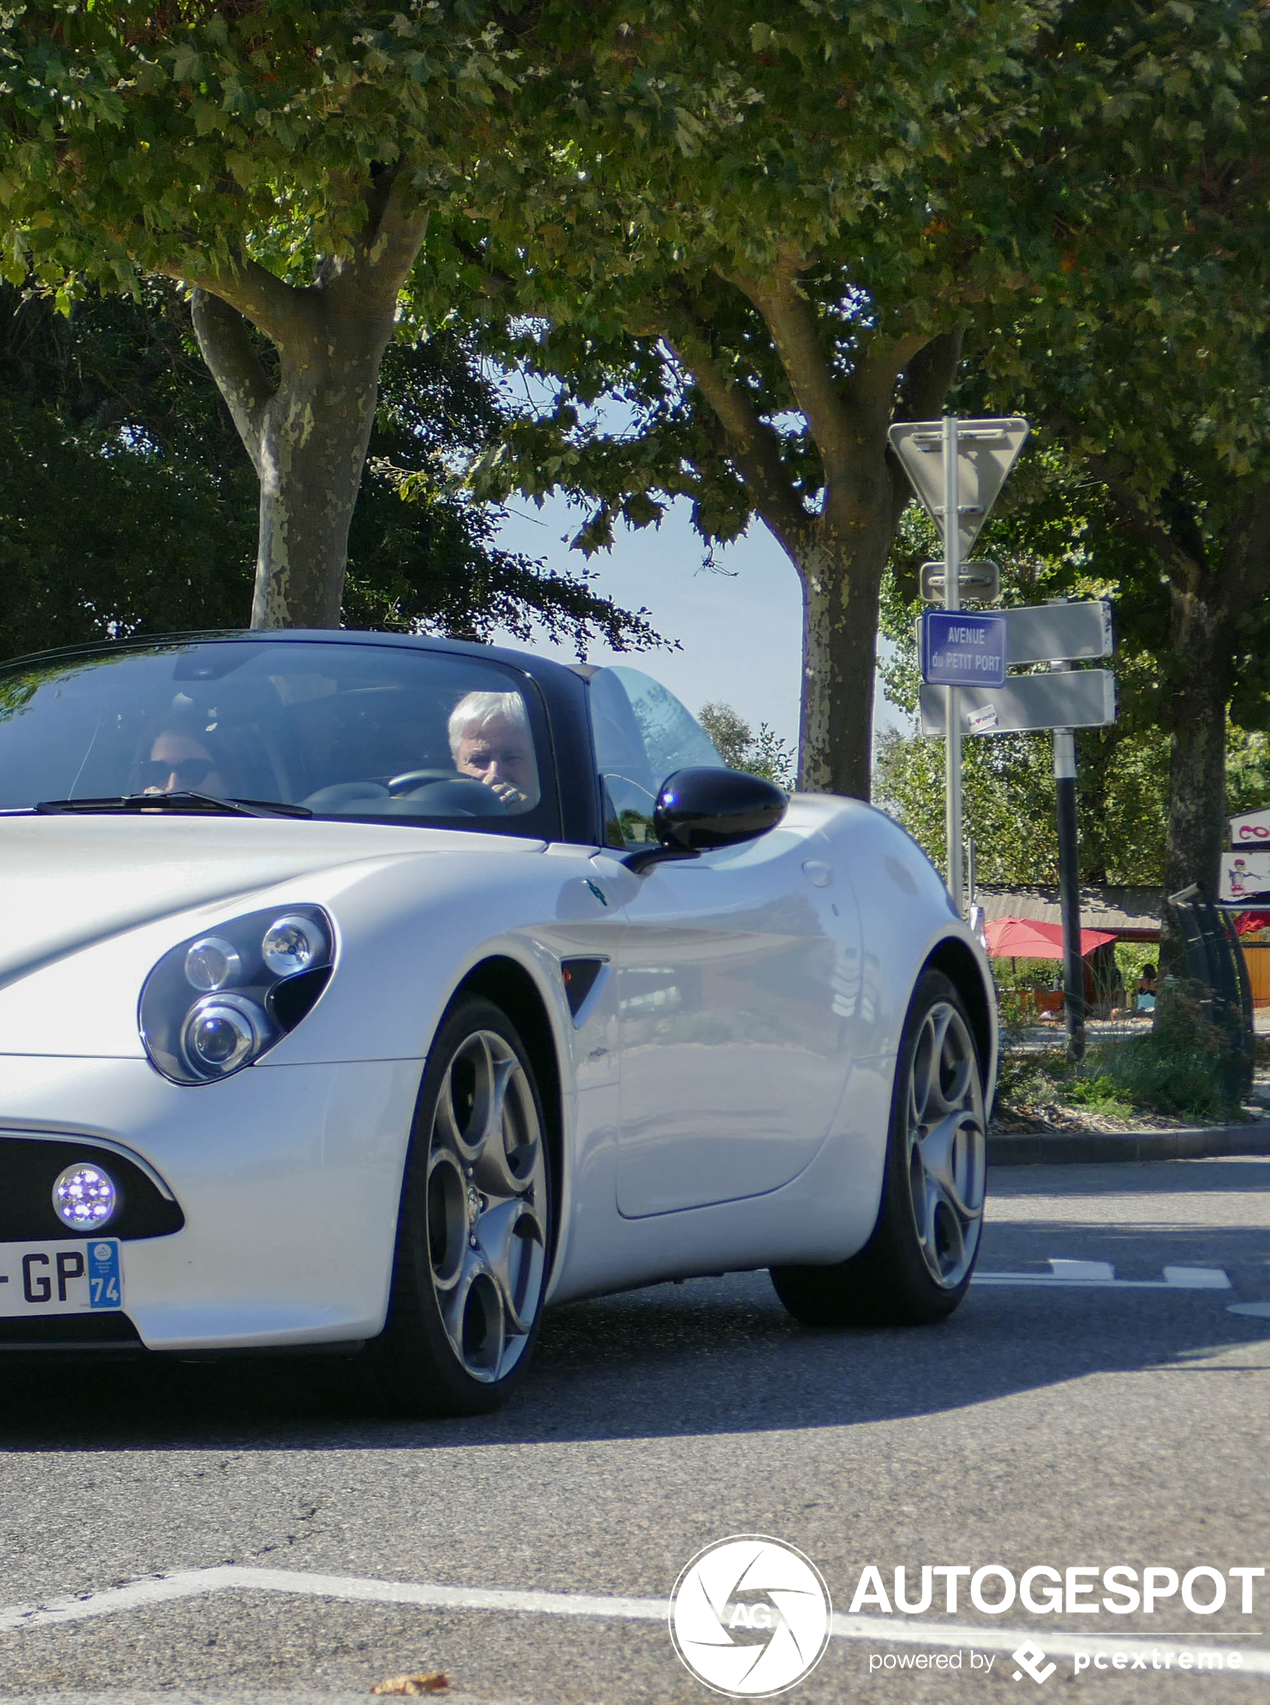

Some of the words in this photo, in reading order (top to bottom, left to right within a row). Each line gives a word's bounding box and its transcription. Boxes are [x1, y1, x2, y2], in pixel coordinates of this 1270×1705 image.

[948, 627, 985, 644] AVENUE
[932, 652, 944, 667] du
[946, 652, 973, 669] PETIT
[975, 655, 1001, 671] PORT
[91, 1277, 119, 1302] 74
